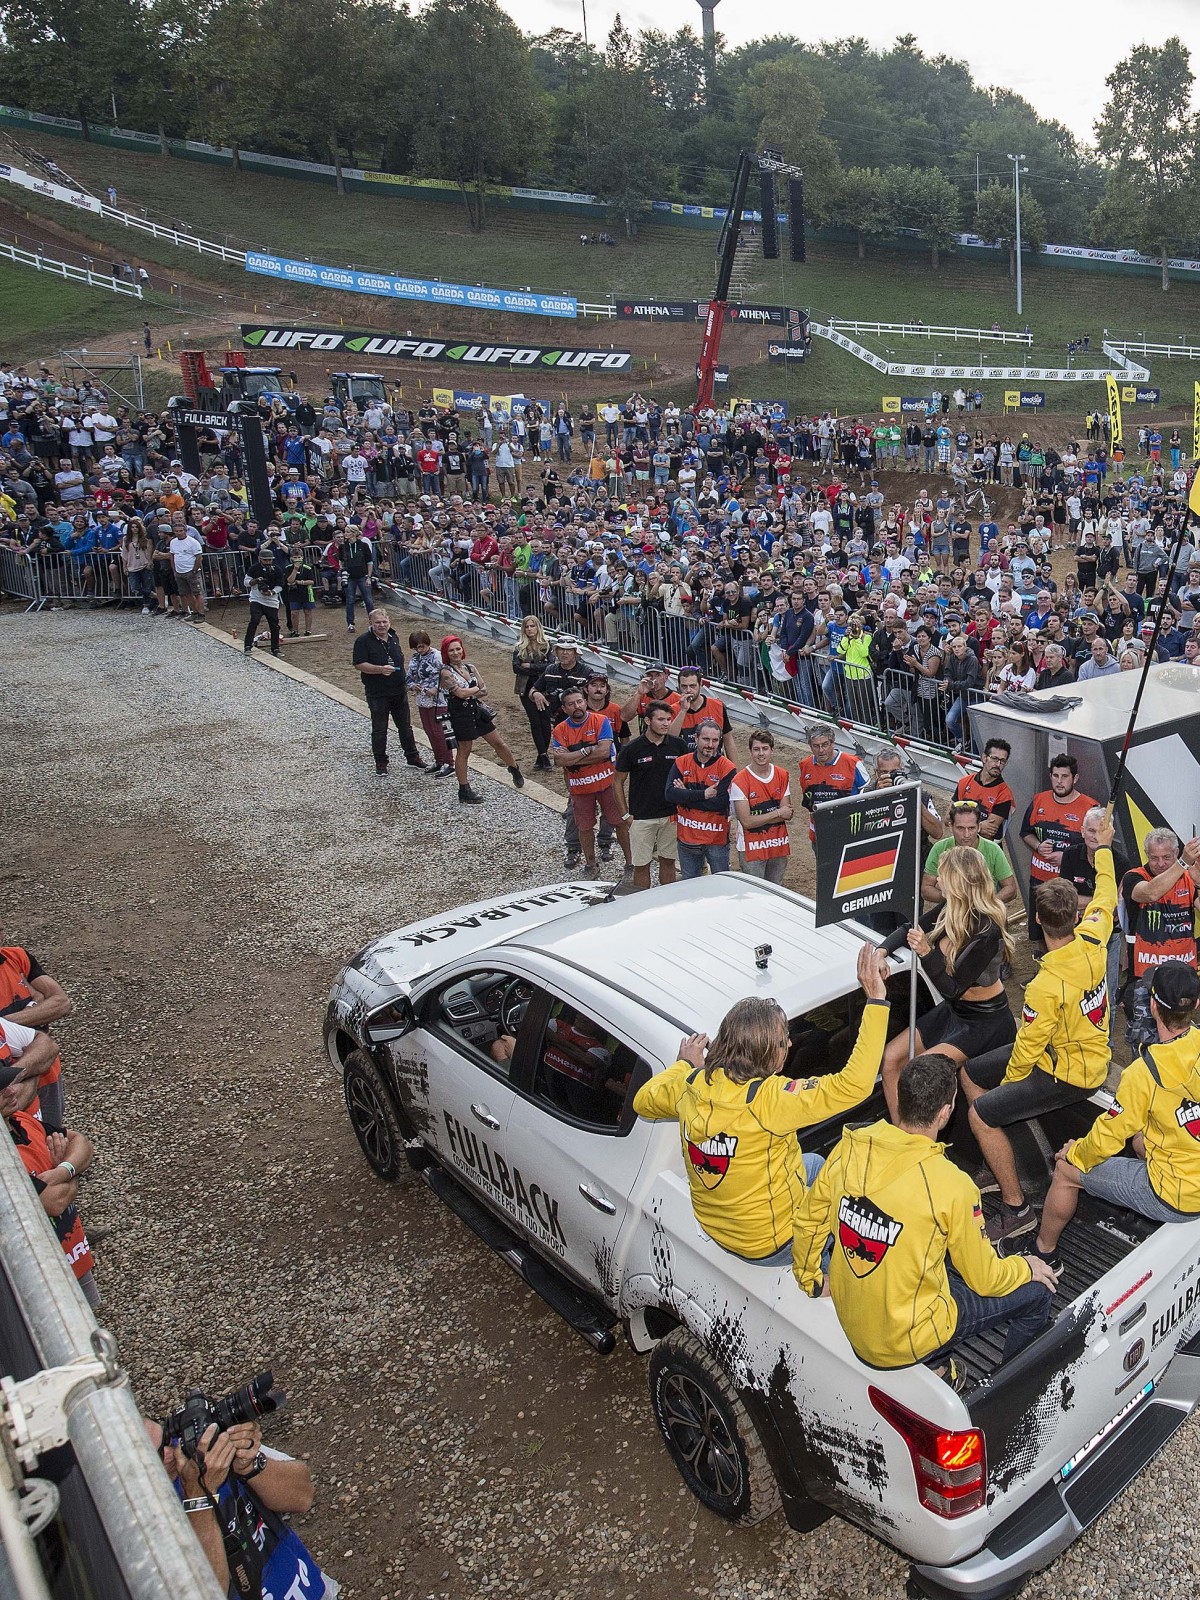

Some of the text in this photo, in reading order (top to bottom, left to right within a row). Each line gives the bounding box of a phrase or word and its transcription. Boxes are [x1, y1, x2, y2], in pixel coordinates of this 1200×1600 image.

[1060, 248, 1083, 256] UniCredit
[1094, 252, 1117, 260] UniCredit
[249, 257, 281, 272] GARDA
[1128, 256, 1151, 264] UniCredit
[284, 264, 318, 278] GARDA
[320, 271, 354, 285] GARDA
[357, 277, 391, 290] GARDA
[394, 282, 428, 295] GARDA
[431, 287, 464, 299] GARDA
[467, 291, 500, 304] GARDA
[504, 296, 537, 308] GARDA
[541, 300, 574, 312] GARDA
[633, 305, 670, 316] ATHENA
[738, 309, 771, 320] ATHENA
[706, 310, 715, 337] MANITOU
[261, 330, 345, 350] UFO
[363, 338, 446, 359] UFO
[462, 346, 541, 365] UFO
[556, 351, 632, 368] UFO
[185, 414, 228, 426] FULLBACK
[569, 769, 614, 787] MARSHALL
[865, 805, 890, 816] MONSTER
[678, 815, 724, 832] MARSHALL
[1046, 828, 1070, 837] MONSTER
[748, 836, 790, 852] MARSHA
[841, 889, 894, 913] GERMANY
[398, 885, 595, 947] FULLBACK
[1162, 910, 1190, 918] MONSTER
[443, 1109, 569, 1248] FULLBACK
[453, 1153, 482, 1186] COSTRUITO
[482, 1182, 493, 1197] PER
[493, 1188, 501, 1203] TE
[506, 1199, 517, 1217] PER
[518, 1208, 524, 1223] IL
[525, 1214, 538, 1234] TUO
[539, 1226, 565, 1257] LAVORO
[853, 1204, 884, 1224] TEAM
[839, 1197, 903, 1246] GERMANY
[1129, 1344, 1142, 1367] FIAT
[235, 1563, 252, 1593] Canon
